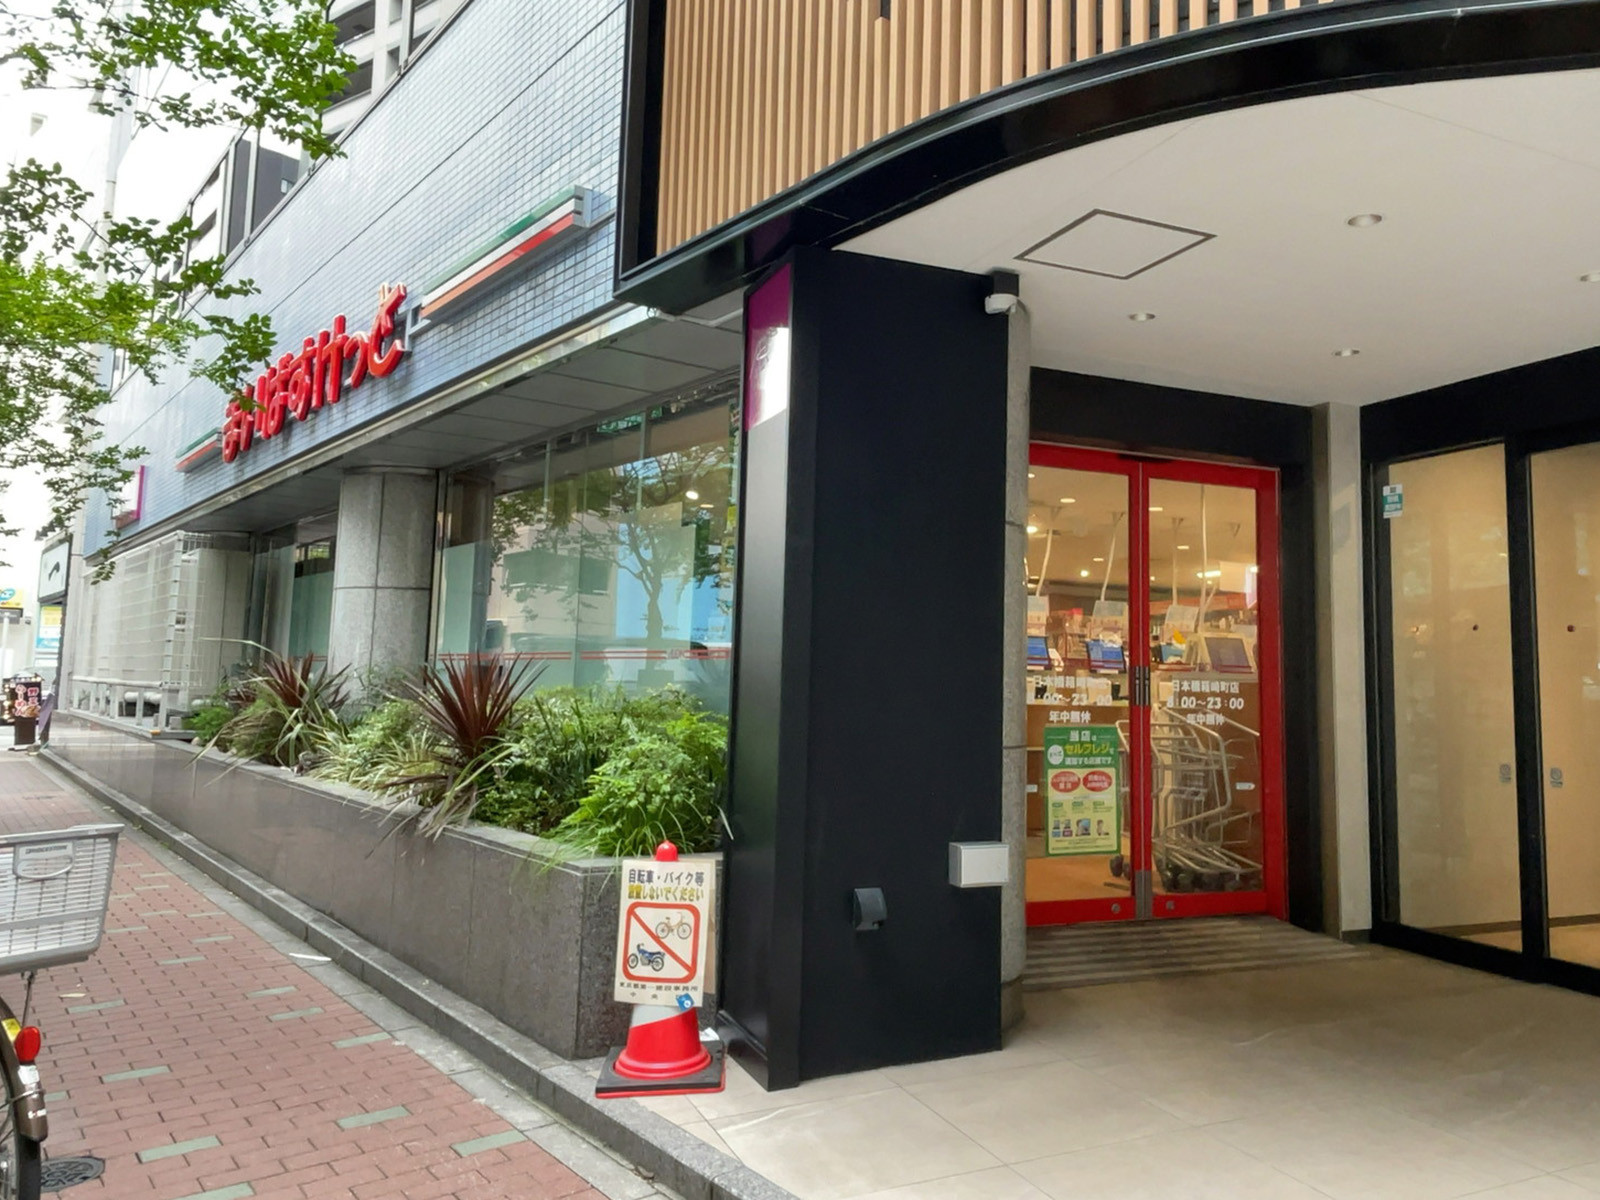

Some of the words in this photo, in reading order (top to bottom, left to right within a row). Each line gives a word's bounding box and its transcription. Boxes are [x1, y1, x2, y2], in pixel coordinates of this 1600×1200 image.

[222, 282, 407, 463] まいばすけっと
[1049, 710, 1091, 723] 年中無休
[628, 868, 705, 887] 自転車・バイク等
[627, 884, 704, 901] 放置しないでください
